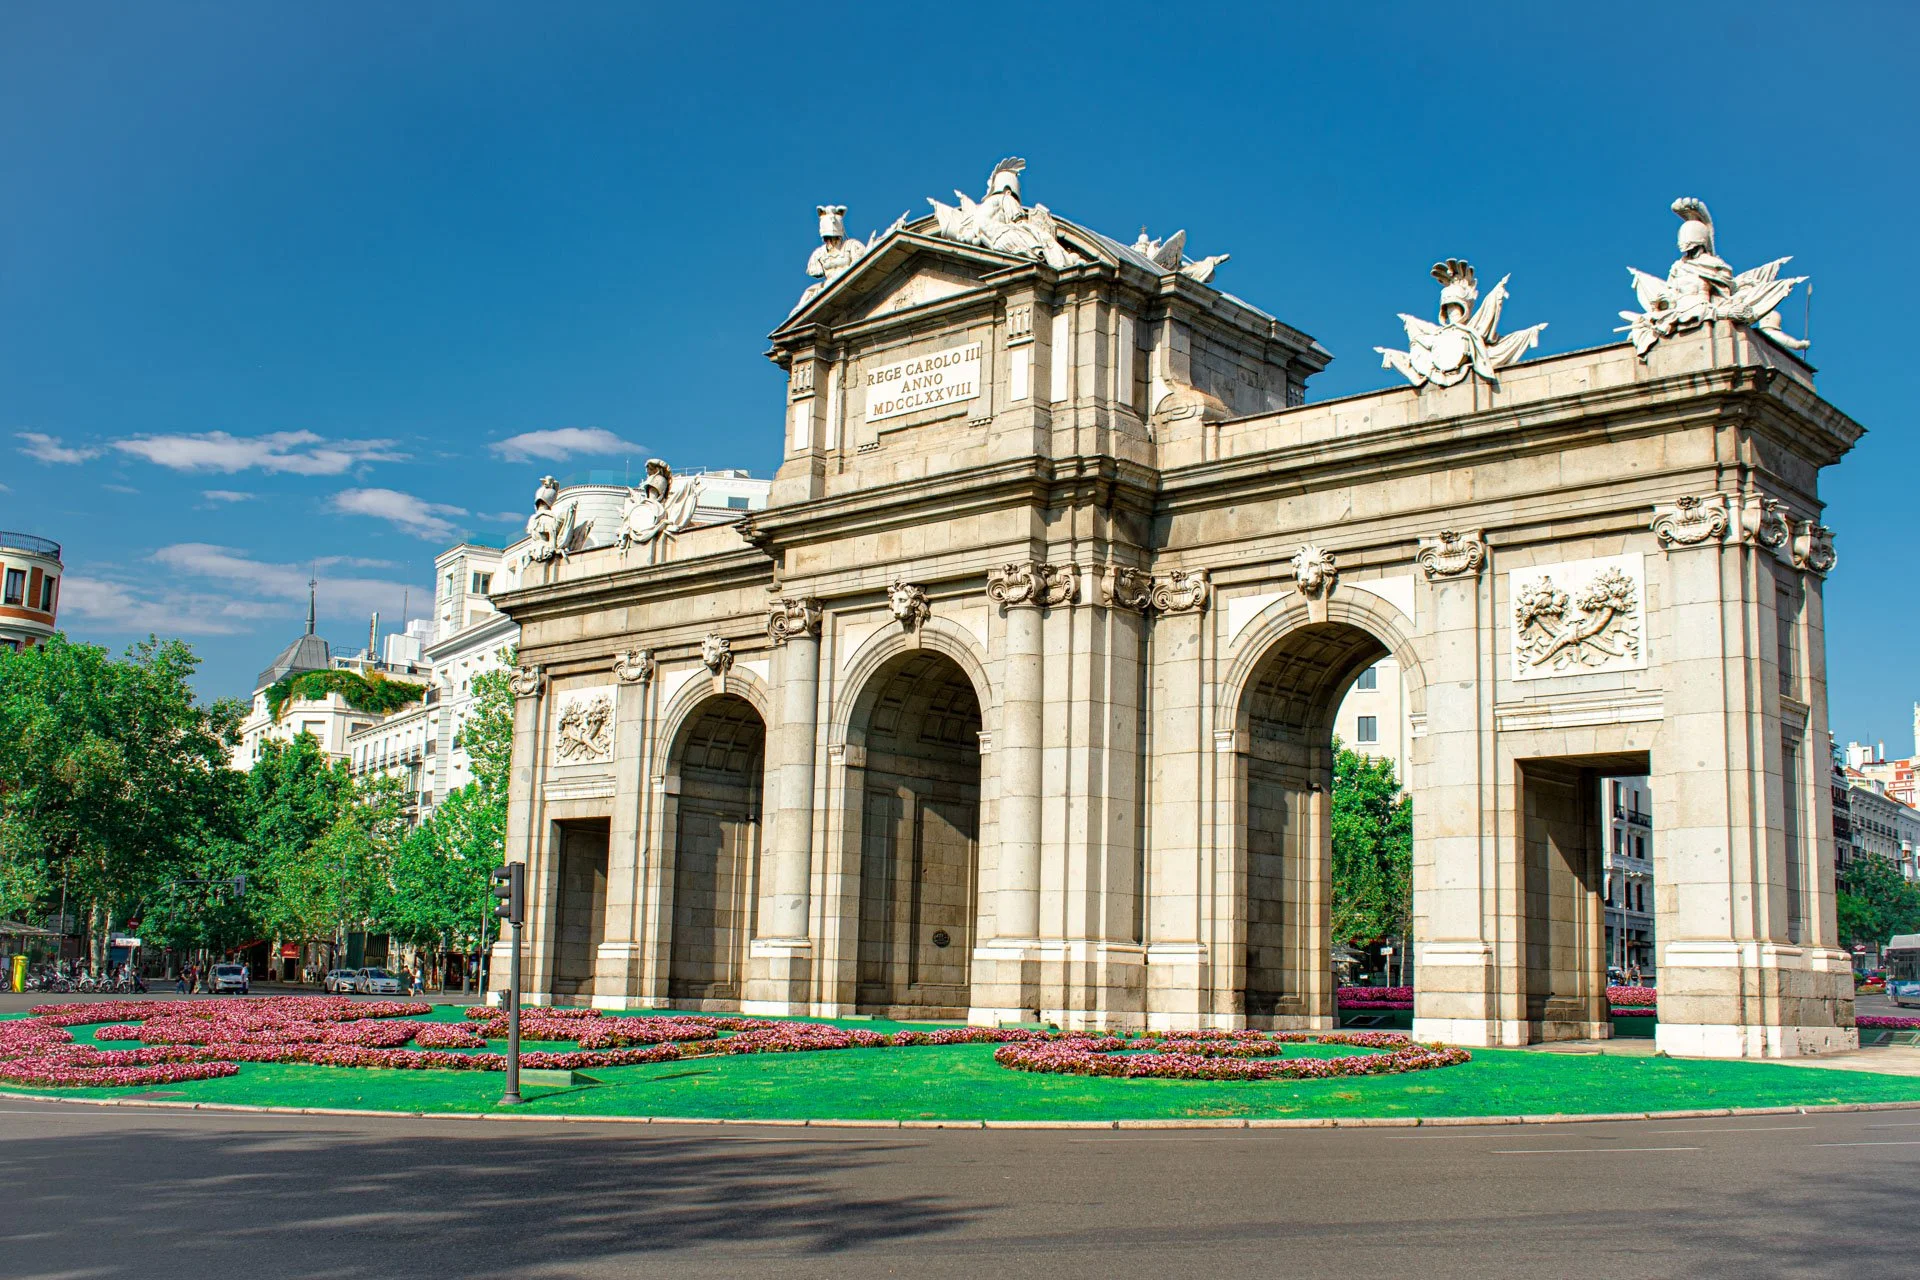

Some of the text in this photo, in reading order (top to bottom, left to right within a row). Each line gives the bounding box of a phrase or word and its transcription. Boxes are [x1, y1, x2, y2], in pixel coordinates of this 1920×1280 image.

[867, 346, 981, 386] REGE CAROLO III
[873, 382, 971, 415] MDCCLXXVIII
[901, 372, 943, 394] ANNO
